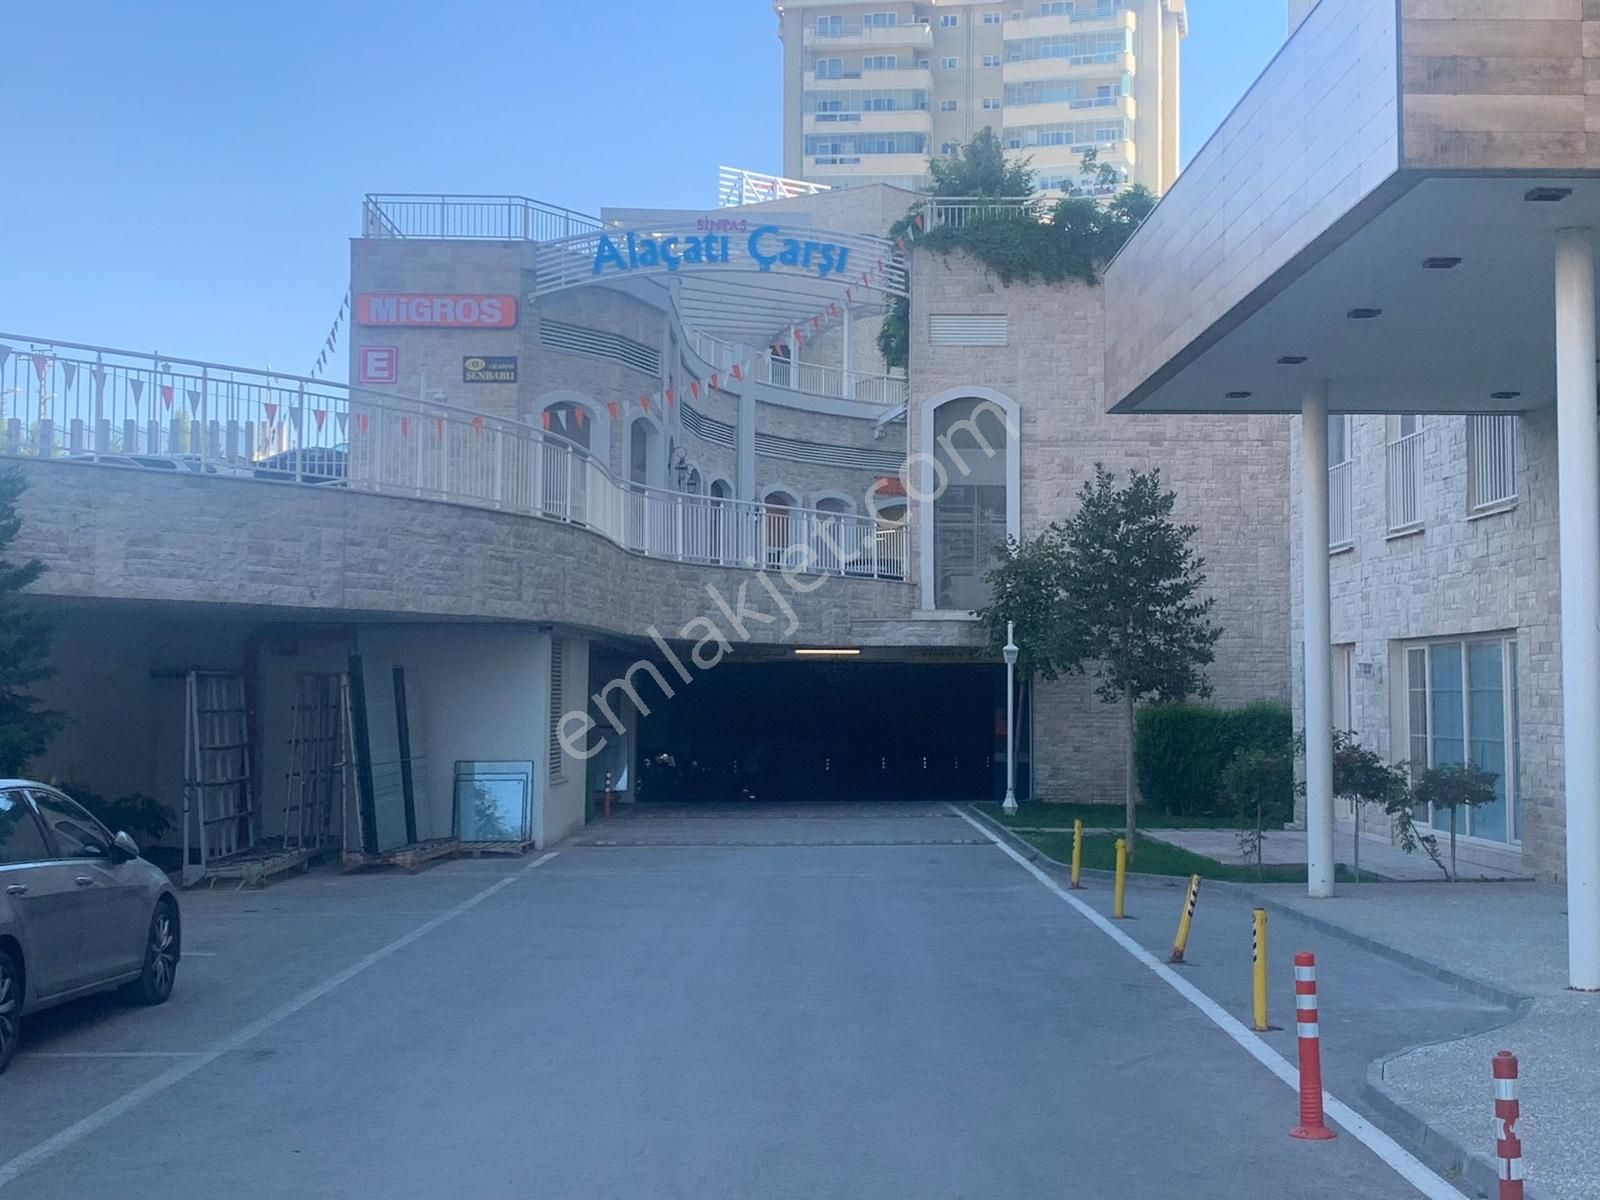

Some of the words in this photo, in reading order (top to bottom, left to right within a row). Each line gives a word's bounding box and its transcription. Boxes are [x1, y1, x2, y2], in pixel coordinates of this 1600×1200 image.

[591, 229, 730, 275] Alaçatı
[748, 225, 849, 276] Çarşı
[366, 351, 389, 377] E
